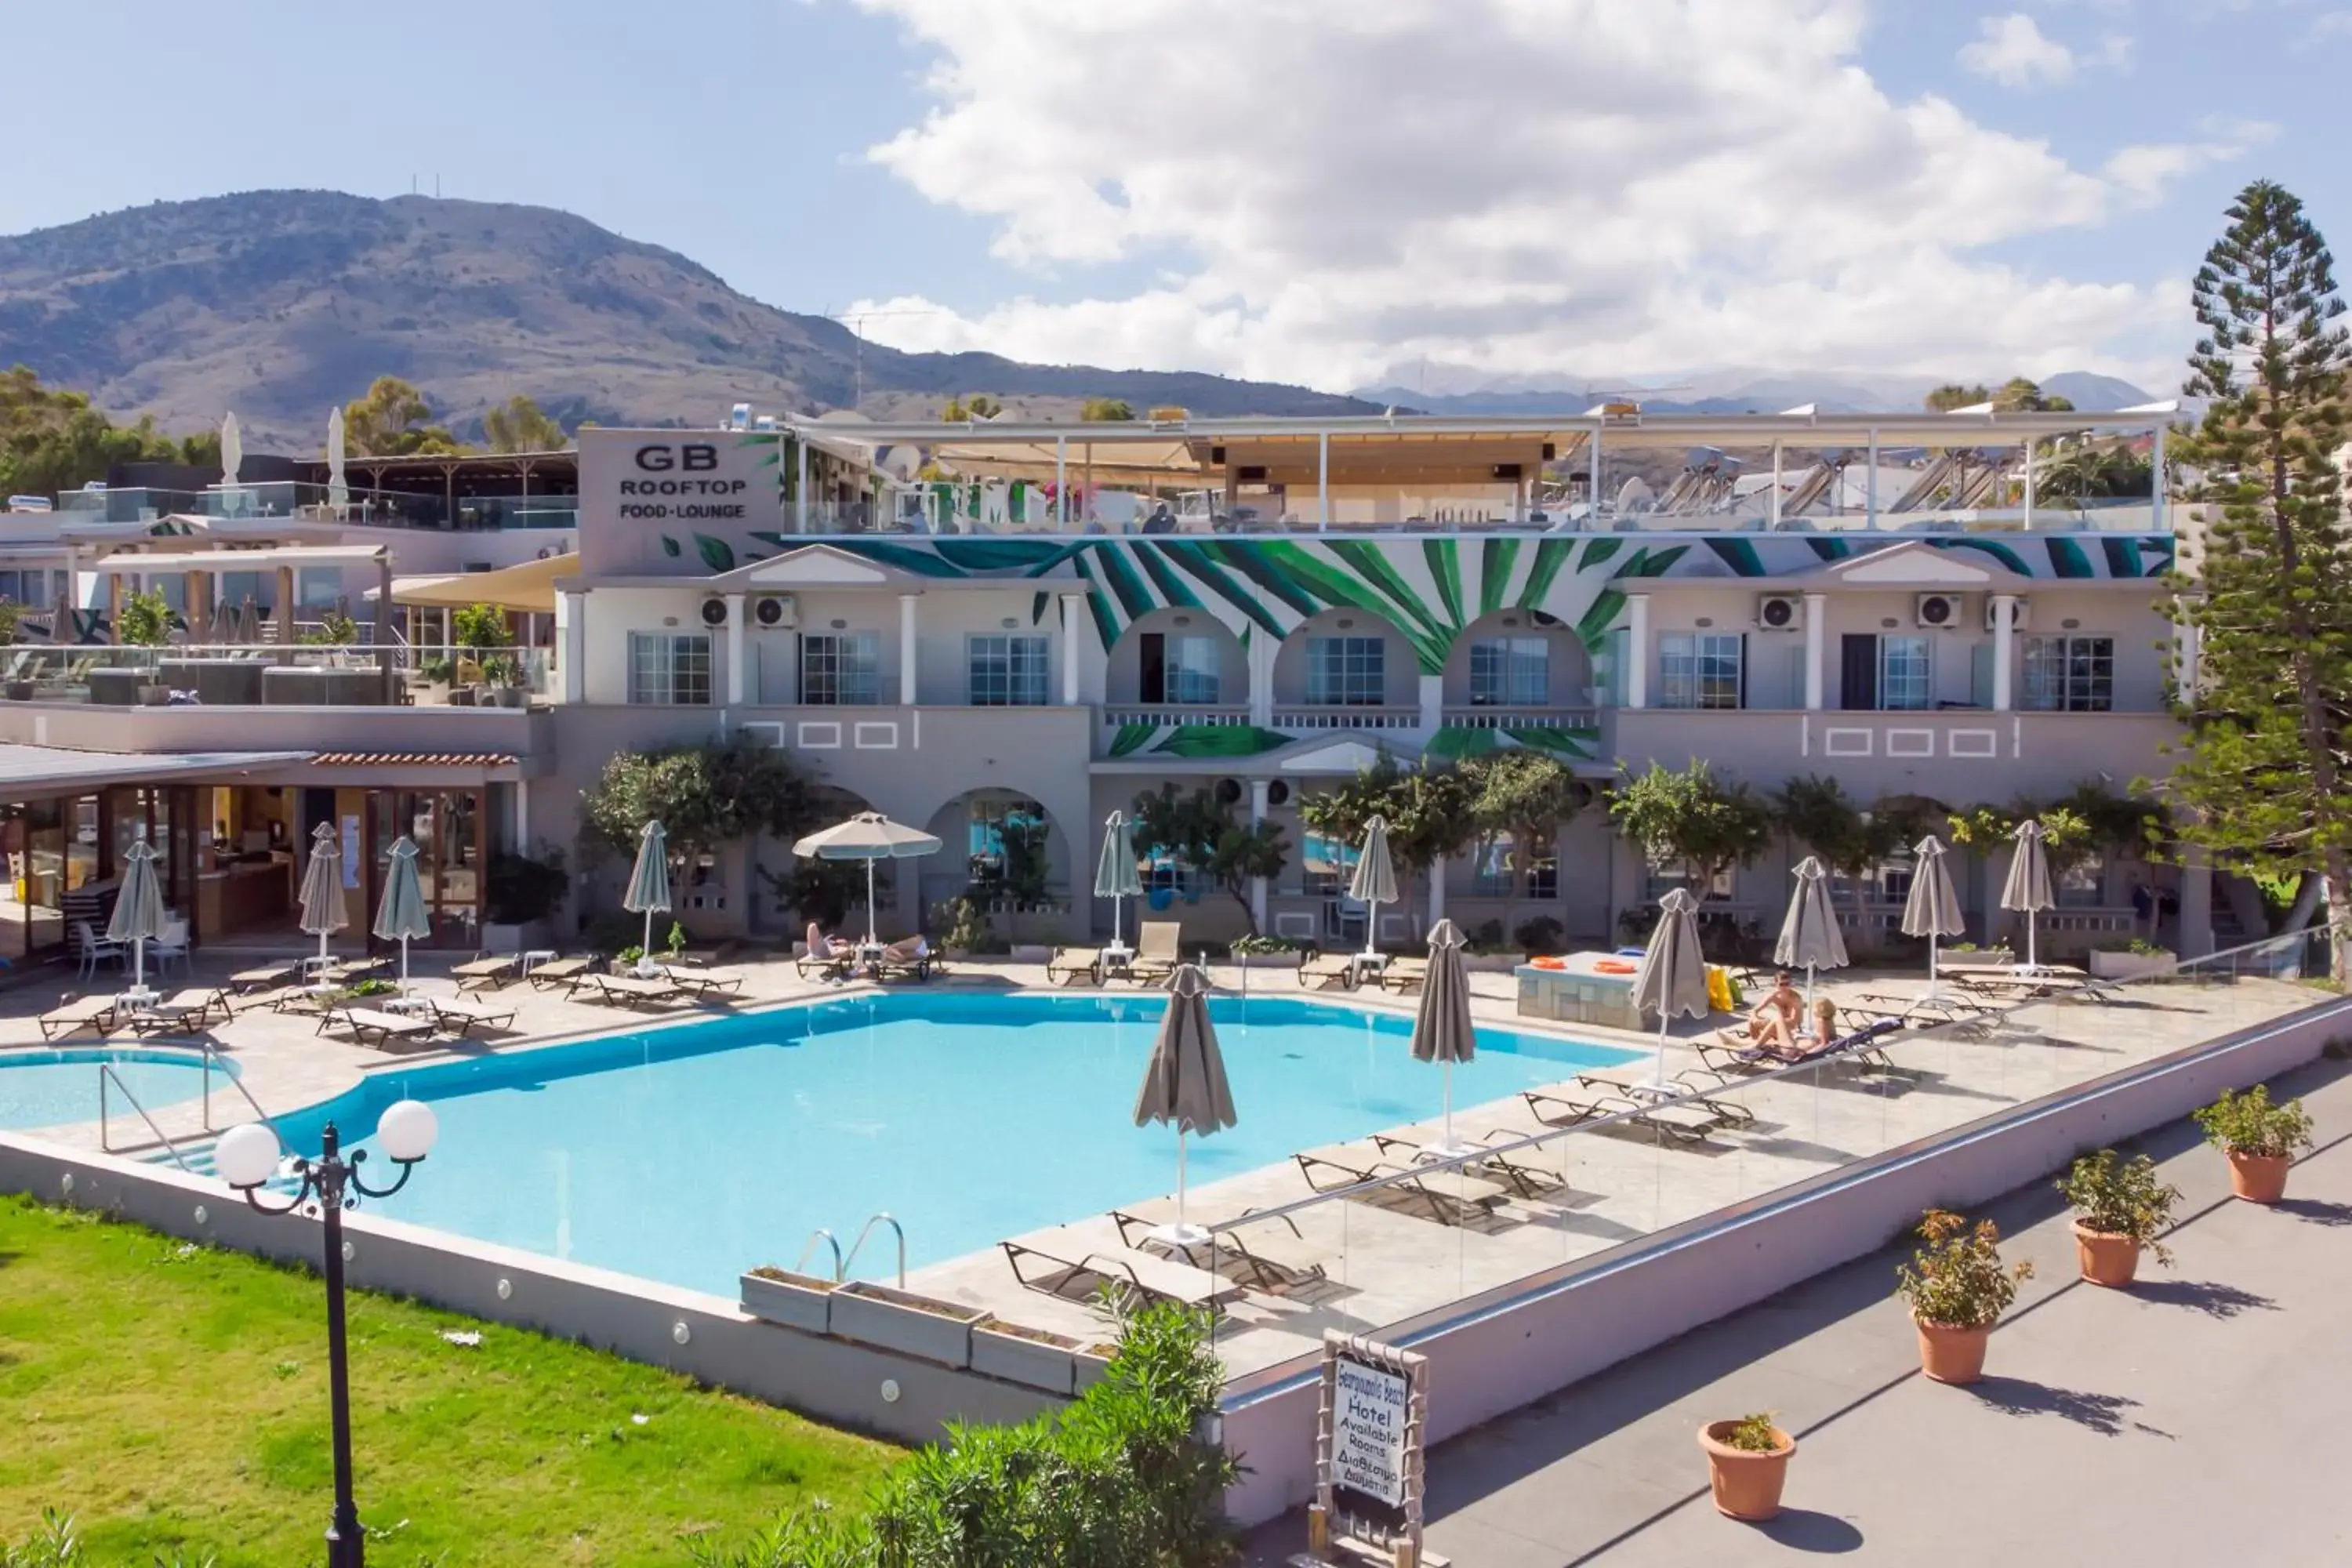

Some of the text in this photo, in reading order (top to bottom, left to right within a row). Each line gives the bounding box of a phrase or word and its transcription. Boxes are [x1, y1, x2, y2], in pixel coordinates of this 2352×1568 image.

[635, 445, 717, 471] GB
[620, 480, 746, 495] ROOFTOP
[1385, 1377, 1404, 1406] Beach
[1348, 1396, 1391, 1428] Hotel
[1340, 1417, 1398, 1446] Available
[1349, 1433, 1386, 1457] Rooms
